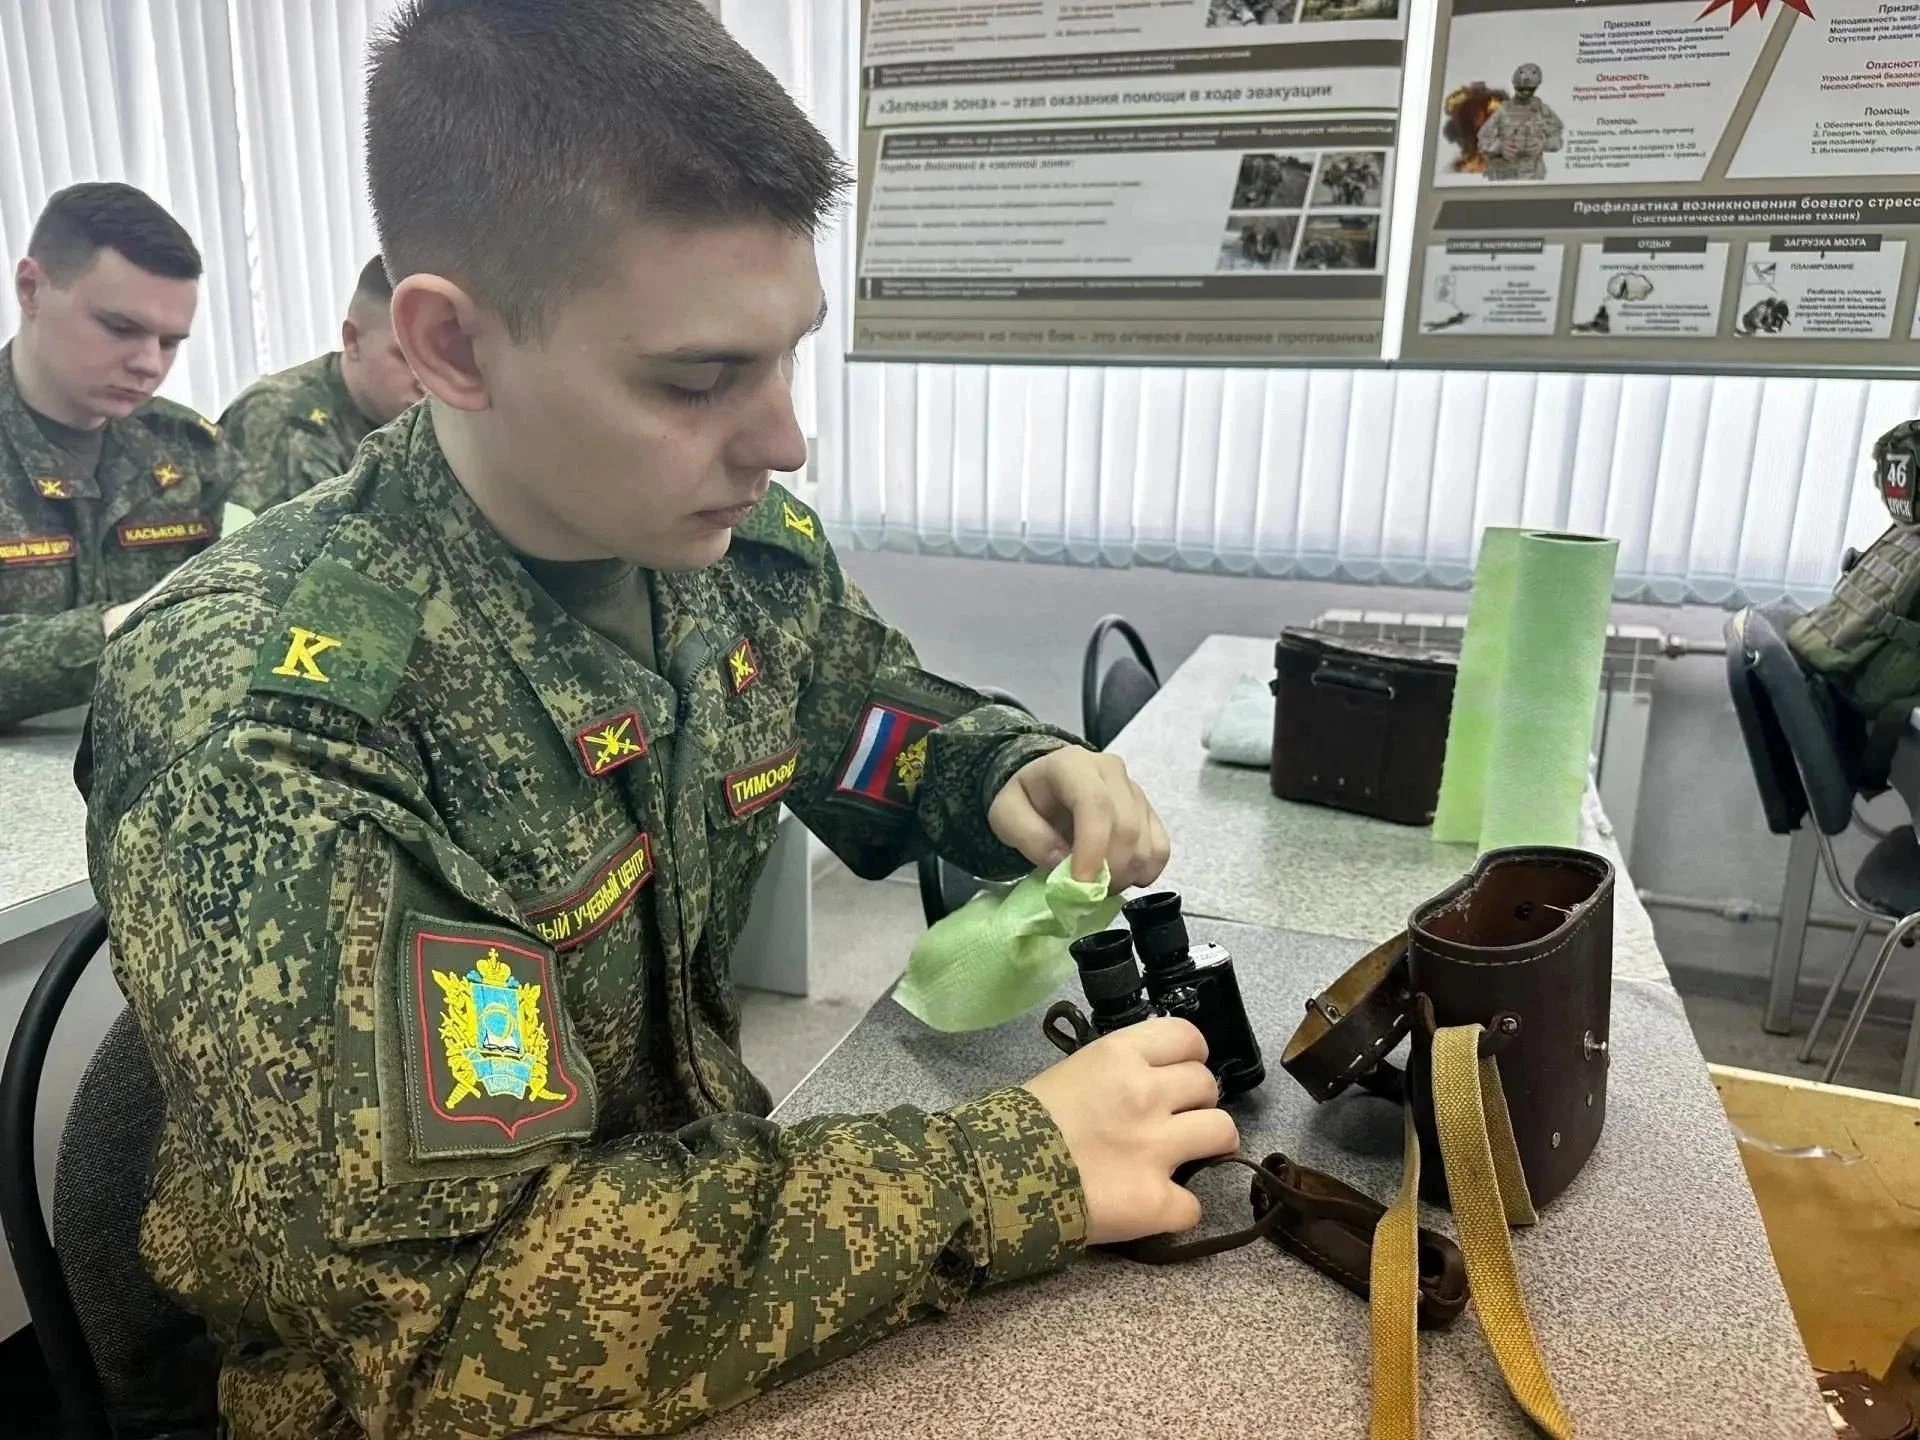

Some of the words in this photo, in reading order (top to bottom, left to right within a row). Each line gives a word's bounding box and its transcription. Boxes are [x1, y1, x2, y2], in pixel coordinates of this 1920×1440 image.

[1878, 4, 1920, 14] Призна
[1603, 20, 1651, 30] Признаки
[1596, 72, 1650, 82] Опасность
[1013, 97, 1046, 109] этап
[1050, 92, 1120, 107] оказания
[1122, 90, 1186, 105] помощи
[1190, 90, 1200, 101] в
[1204, 88, 1243, 102] ходе
[1246, 84, 1334, 100] эвакуации
[1864, 106, 1910, 116] Помощь
[1596, 117, 1638, 126] Помощь
[1572, 200, 1679, 214] Профилактика
[1682, 199, 1797, 212] возникновения
[1800, 196, 1864, 209] боевого
[1868, 197, 1920, 210] стресс
[1632, 214, 1735, 225] (систематическое
[1738, 212, 1812, 222] выполнение
[1814, 210, 1861, 222] техник)
[1784, 238, 1832, 248] ЗАГРУЗКА
[1834, 238, 1867, 247] МОЗГА
[1888, 462, 1907, 488] 46
[574, 870, 622, 930] УЧЕБНЫЙ
[618, 848, 644, 890] ЦЕНТР
